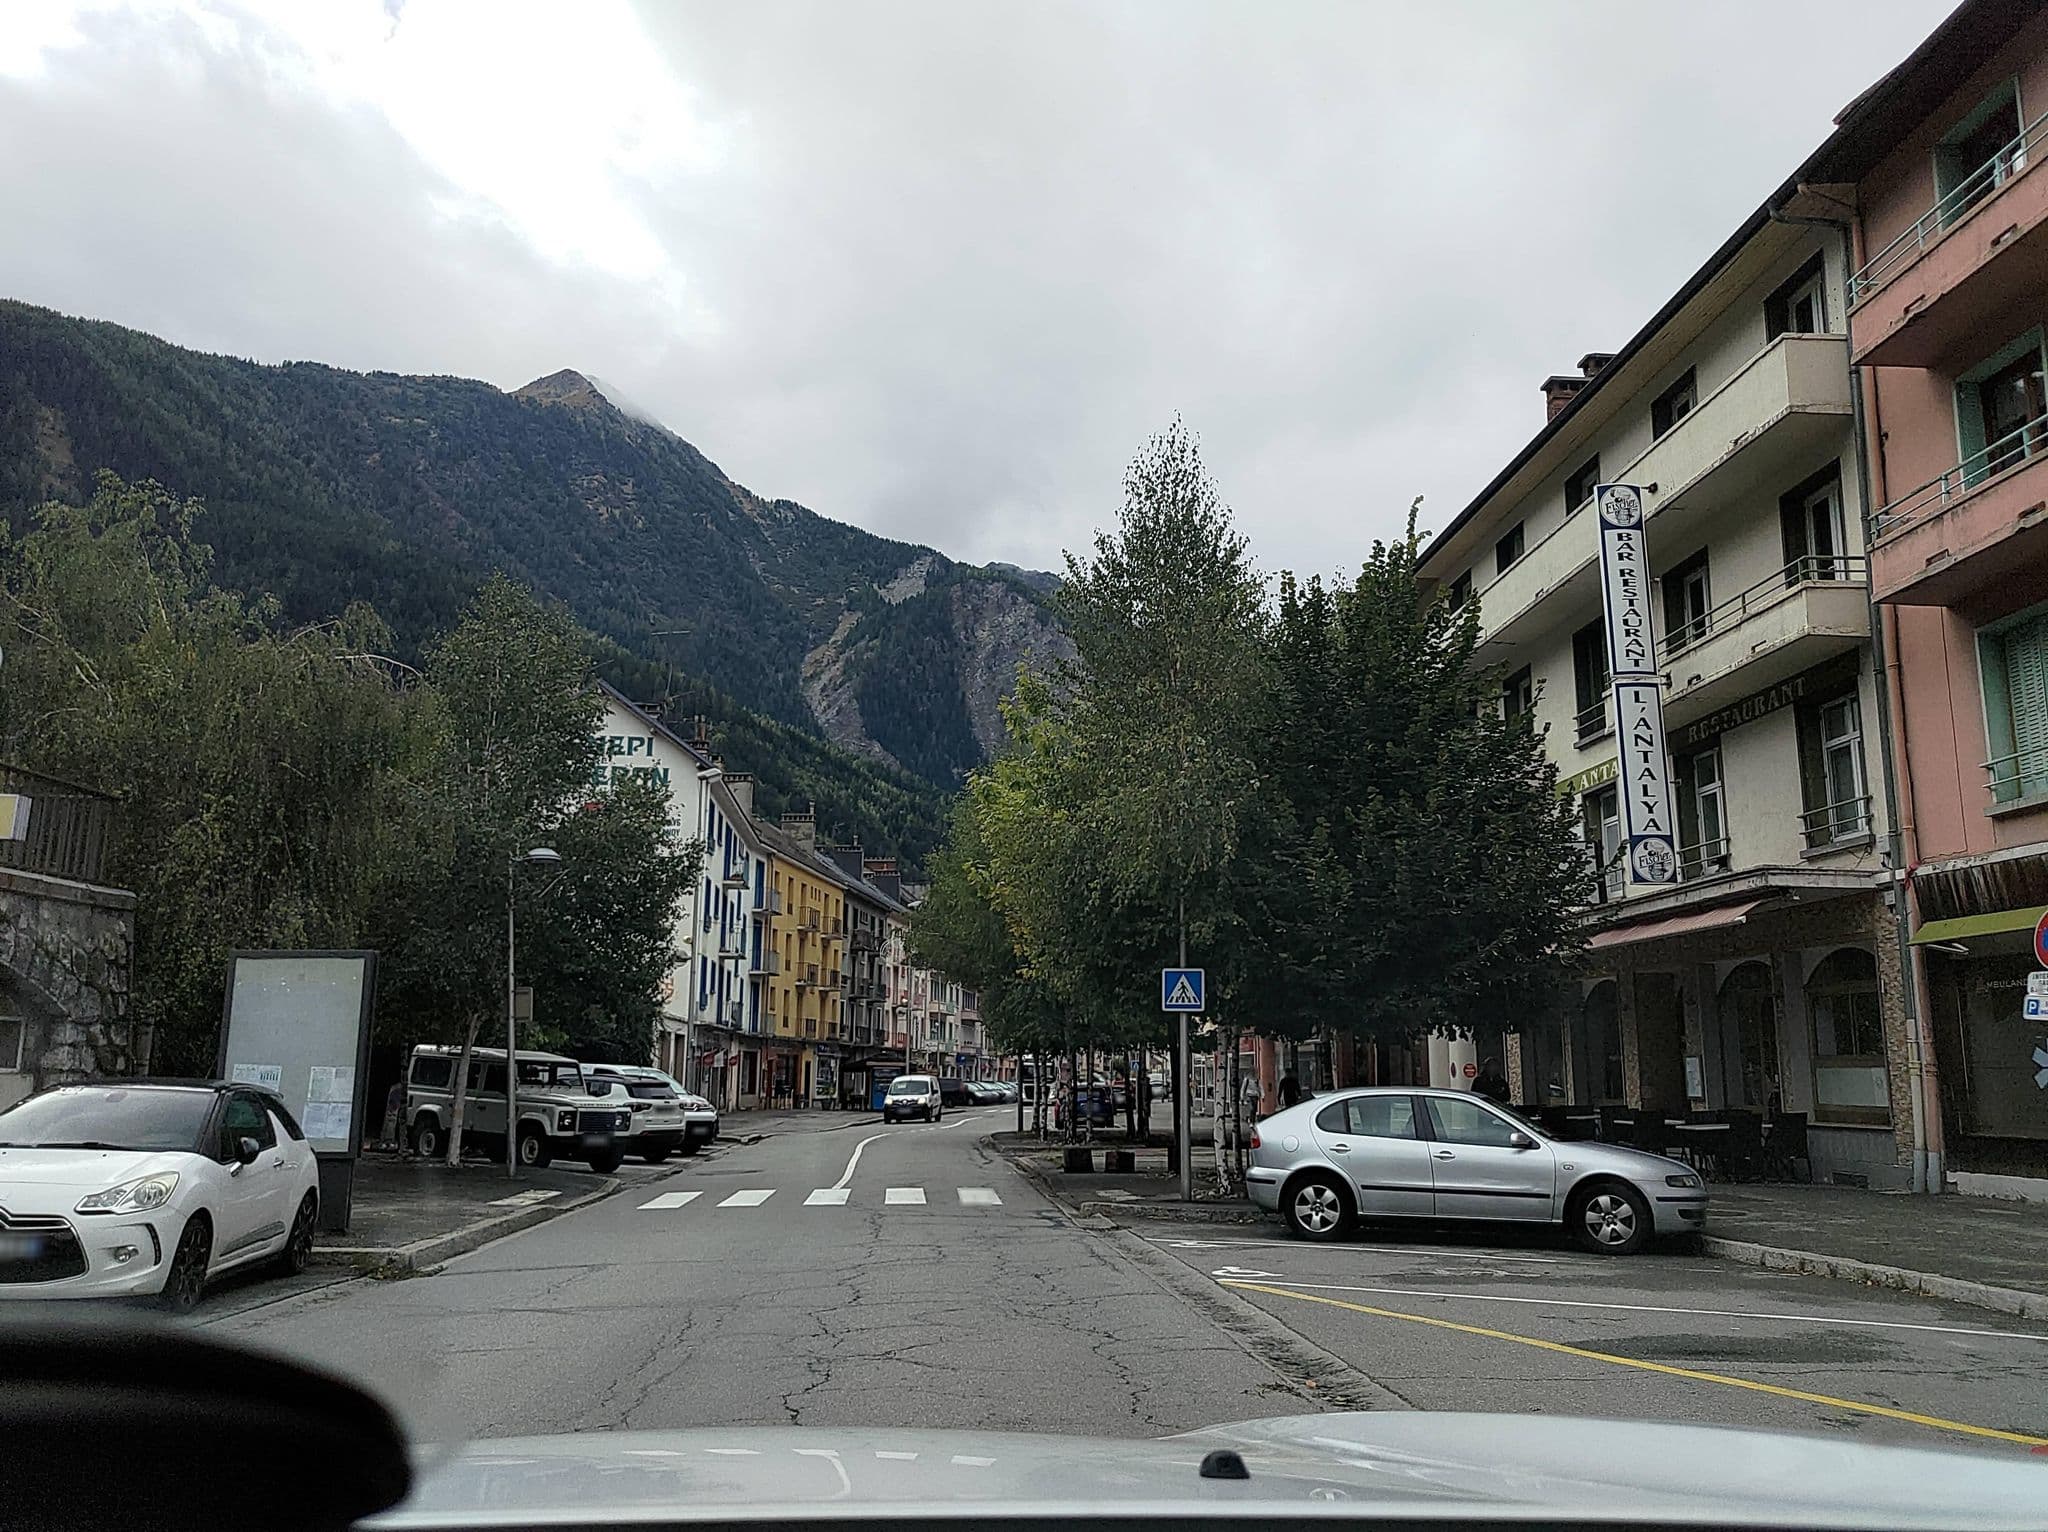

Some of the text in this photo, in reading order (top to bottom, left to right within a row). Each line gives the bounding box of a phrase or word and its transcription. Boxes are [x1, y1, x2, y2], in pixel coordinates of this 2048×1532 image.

[1616, 533, 1646, 667] BAR RESTAURANT
[1688, 677, 1806, 743] RESTAURANT
[1633, 690, 1662, 831] L'ANTALYA
[2028, 1001, 2036, 1013] P
